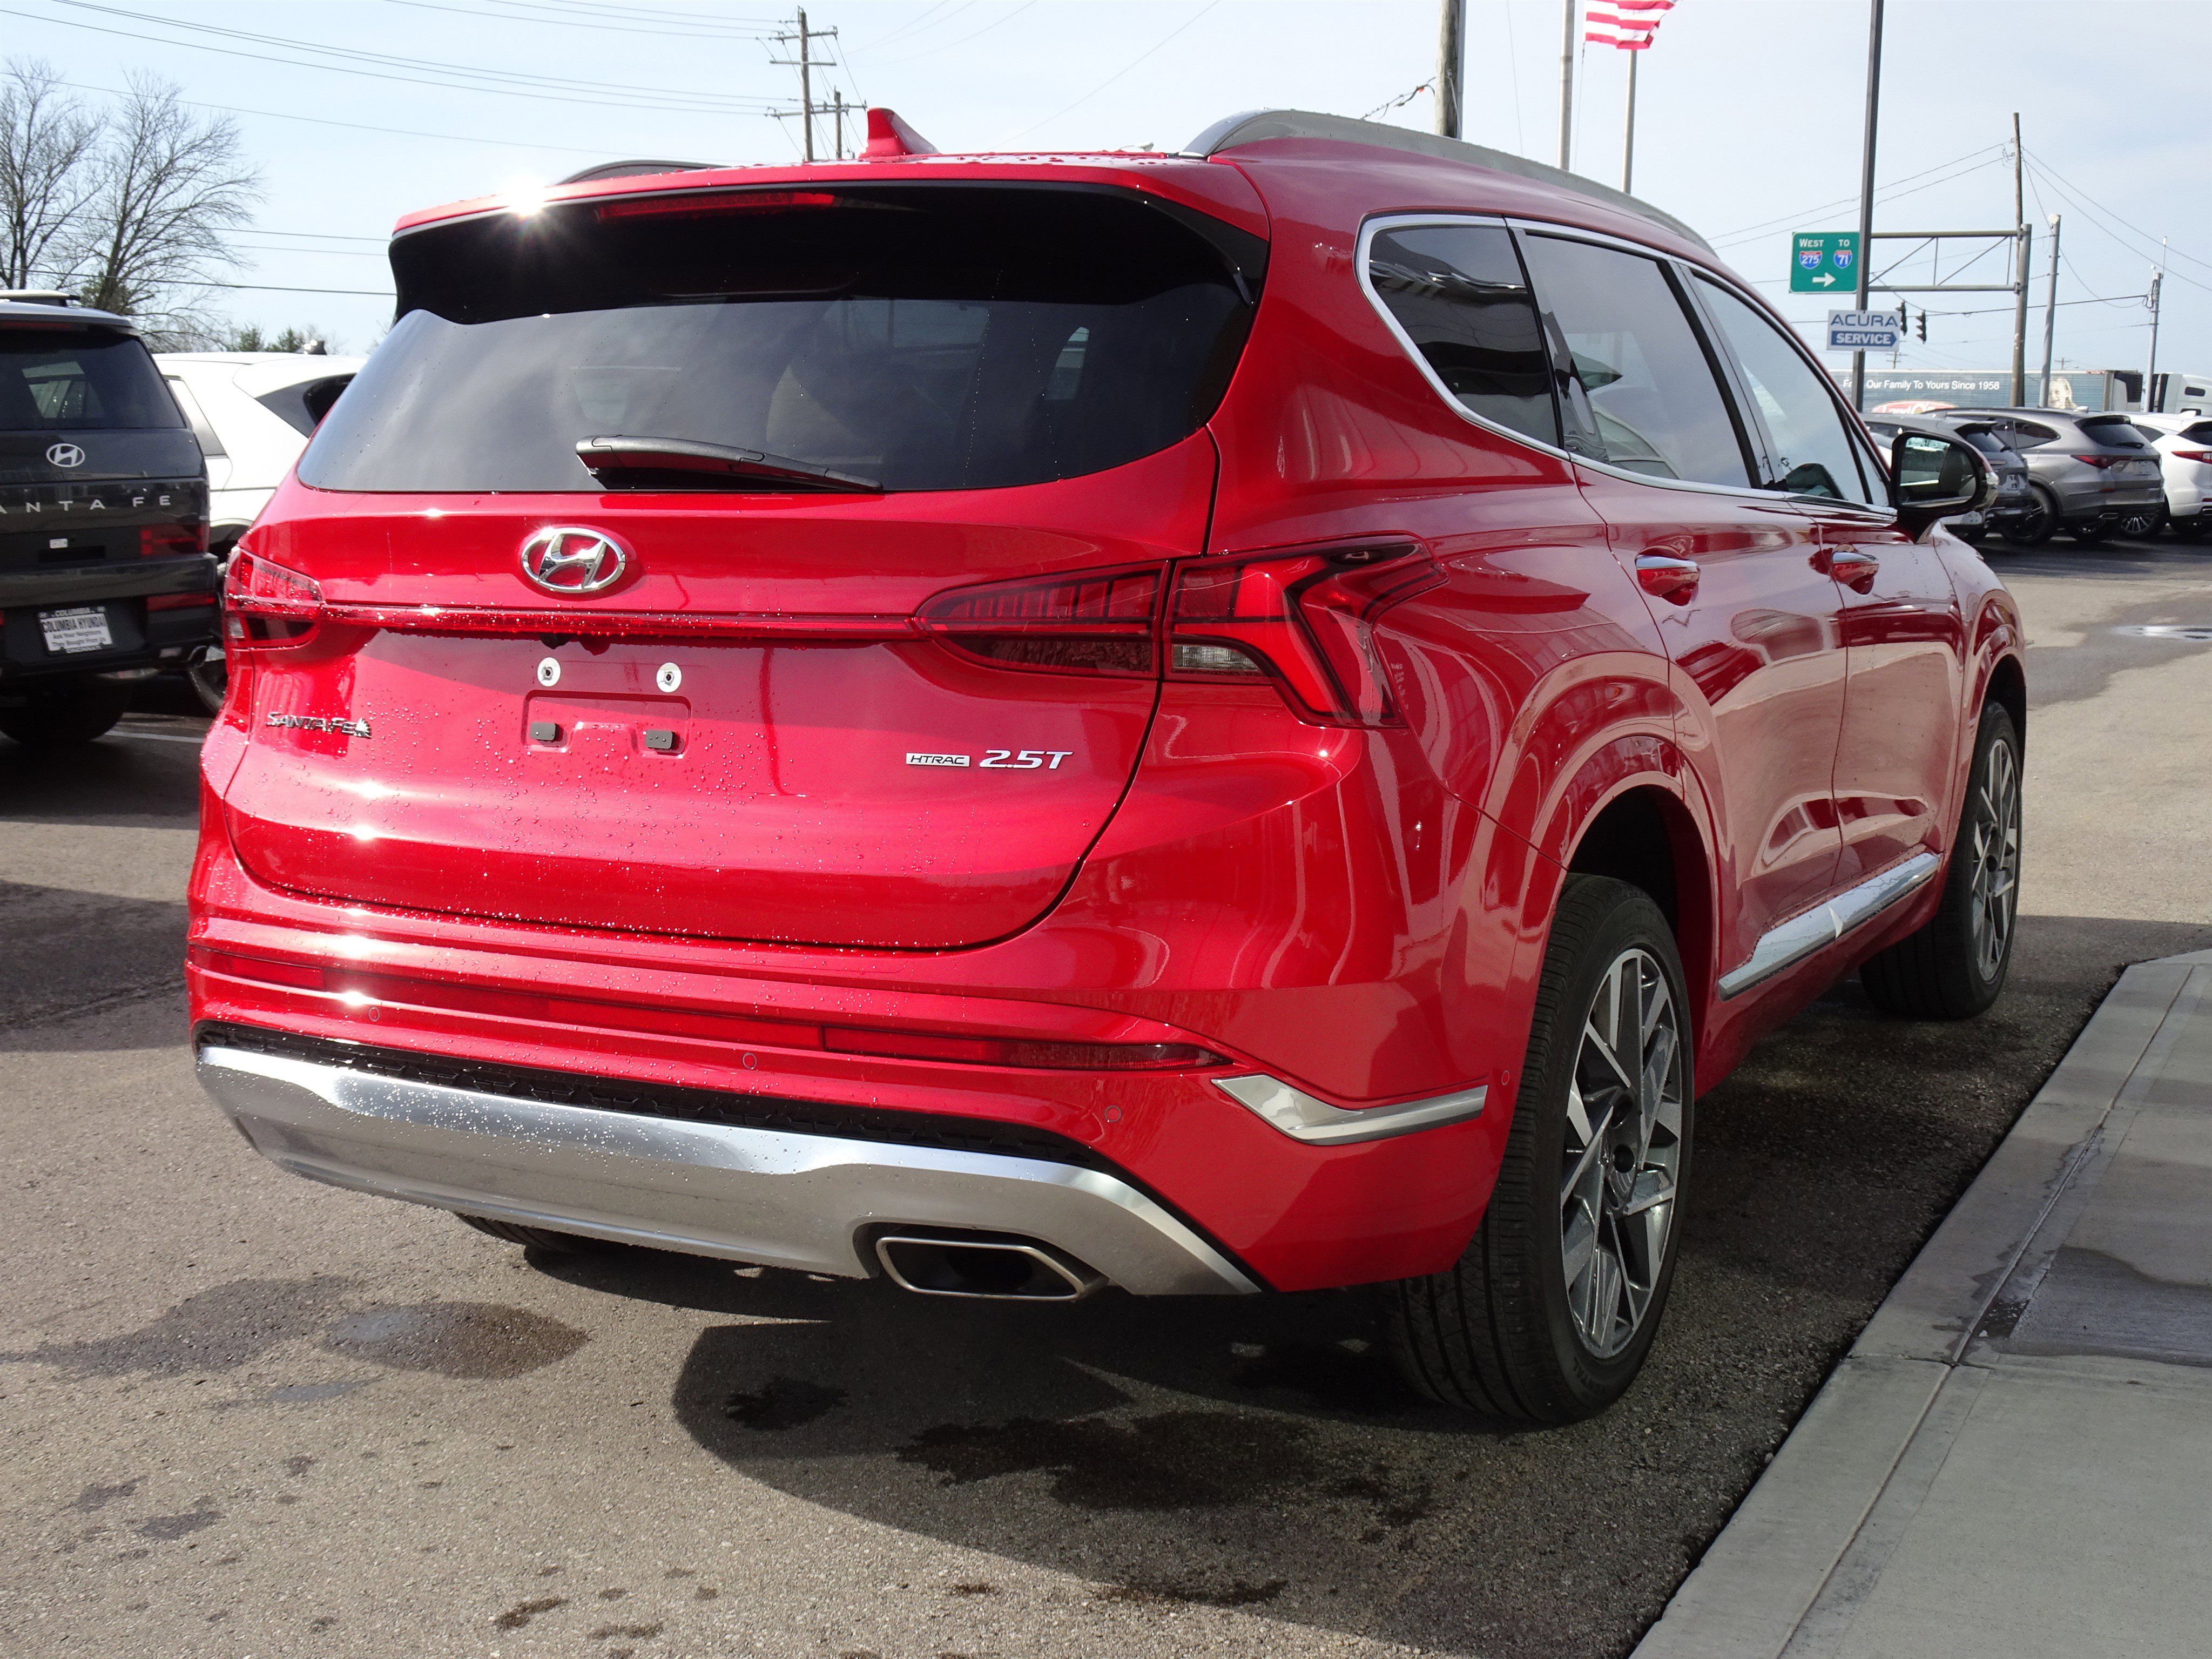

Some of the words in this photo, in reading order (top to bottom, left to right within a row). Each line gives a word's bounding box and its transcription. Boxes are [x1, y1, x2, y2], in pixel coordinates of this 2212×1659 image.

[1799, 238, 1824, 247] WEST
[1802, 255, 1819, 264] 275
[1838, 255, 1849, 265] 71
[1830, 314, 1898, 327] ACURA
[1836, 333, 1891, 344] SERVICE
[1866, 380, 1882, 389] Our
[1884, 380, 1911, 390] Family
[1913, 380, 1924, 389] To
[1926, 380, 1950, 389] Yours
[1951, 380, 1975, 390] Since
[1979, 381, 2000, 390] 1958
[132, 495, 171, 507] FE
[43, 618, 77, 633] COLUMBIA
[76, 615, 107, 630] HYUNDAI
[265, 711, 326, 732] SANTA
[911, 755, 965, 765] HTRAC
[979, 750, 1074, 770] 2.5T
